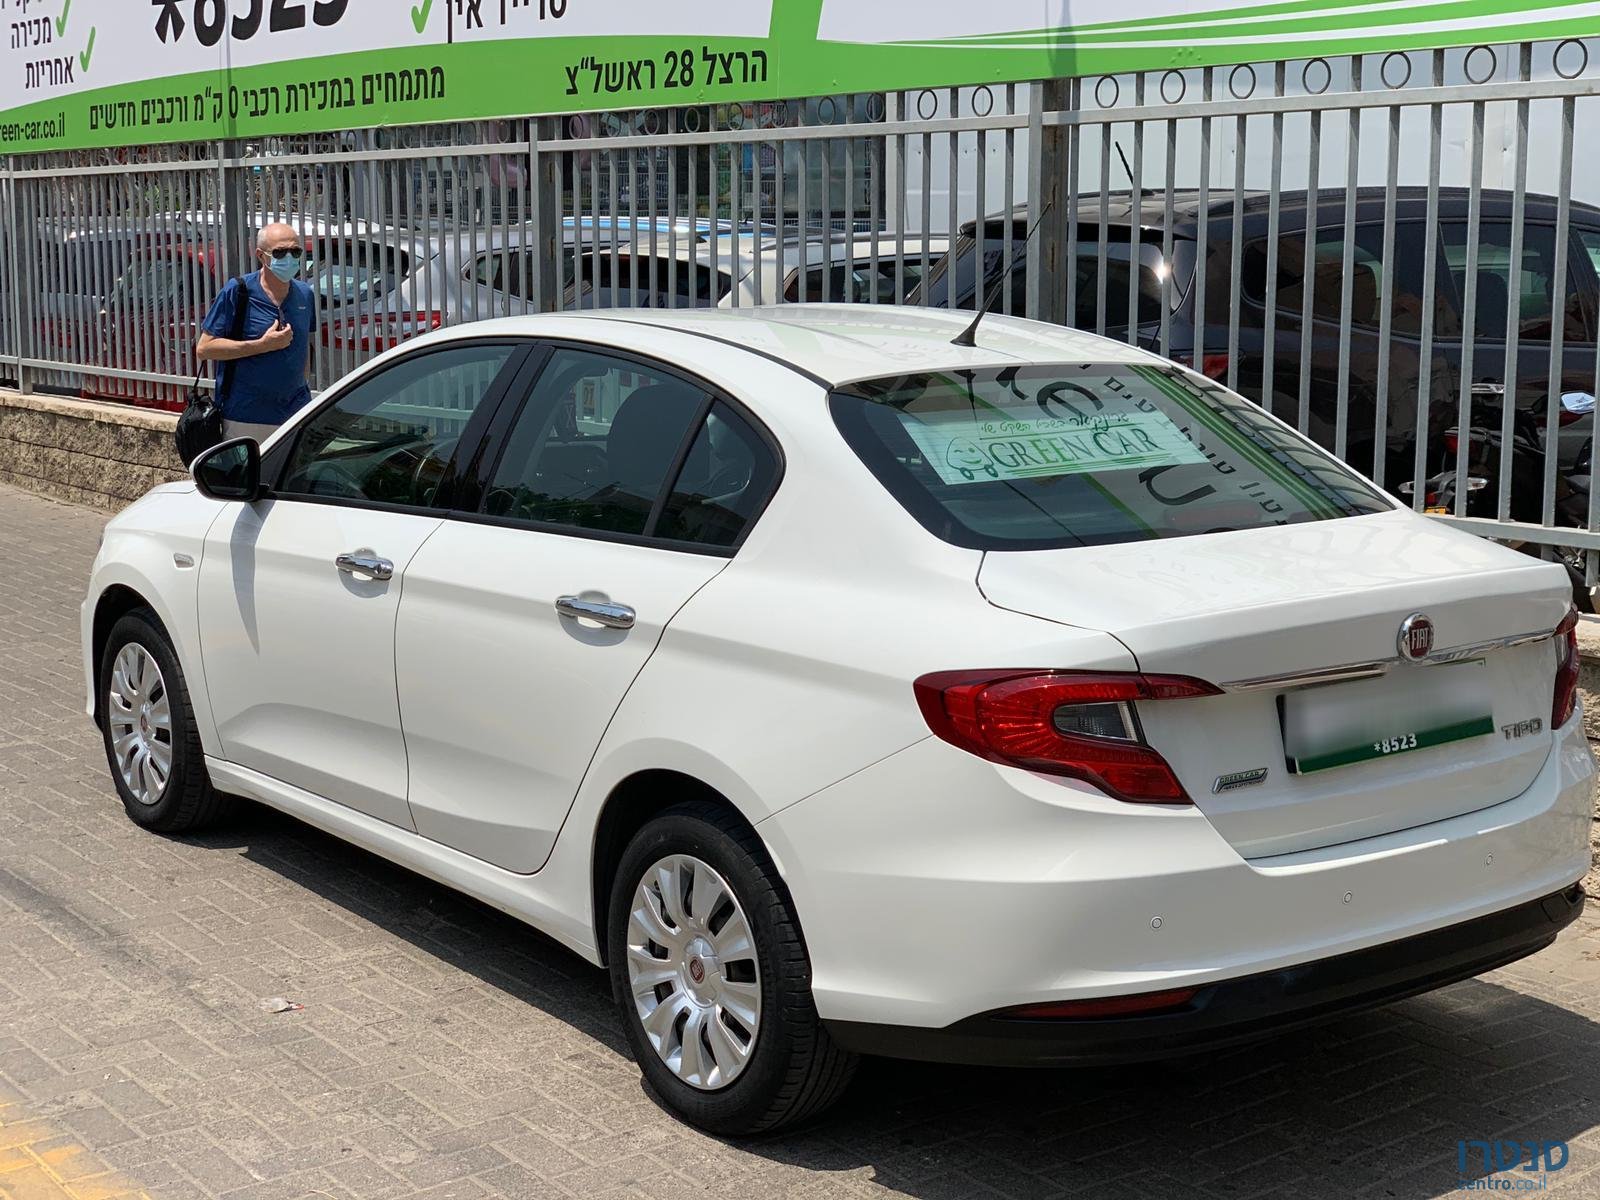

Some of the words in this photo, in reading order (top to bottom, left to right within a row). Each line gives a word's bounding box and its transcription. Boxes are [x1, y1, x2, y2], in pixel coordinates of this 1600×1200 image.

[11, 16, 51, 49] מכירה
[25, 56, 74, 89] אחריות
[664, 49, 695, 88] 28
[702, 46, 768, 86] הרצל
[228, 85, 239, 119] 0
[243, 86, 280, 117] רכבי
[285, 77, 356, 114] במכירת
[362, 66, 445, 105] מתמחים
[90, 102, 136, 130] חדשים
[141, 96, 188, 125] ורכבים
[988, 434, 1096, 469] GREEN
[1092, 428, 1165, 458] CAR
[1411, 627, 1429, 651] FIAT
[1501, 717, 1543, 741] TIPO
